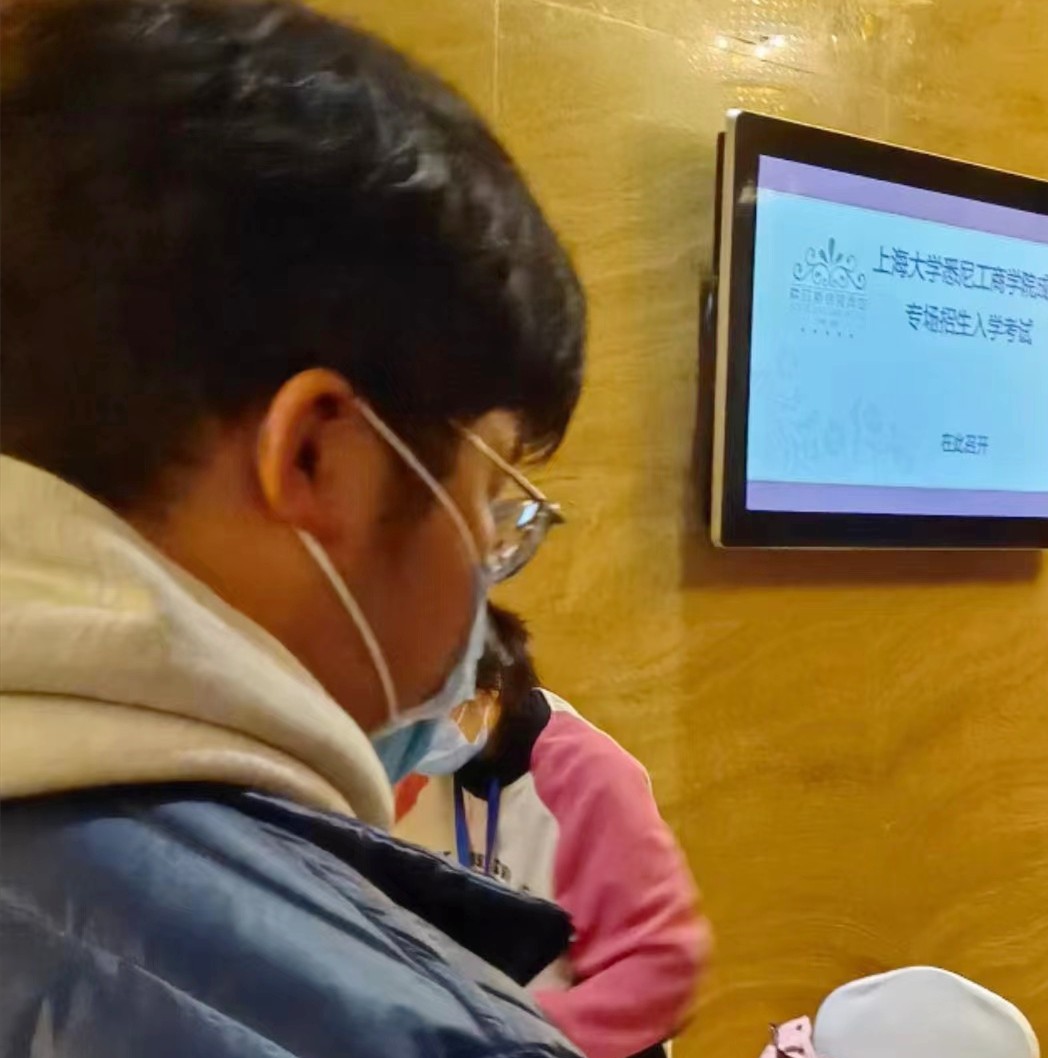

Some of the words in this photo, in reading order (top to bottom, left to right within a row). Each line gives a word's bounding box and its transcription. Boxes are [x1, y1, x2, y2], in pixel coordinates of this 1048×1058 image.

[905, 302, 1034, 345] 专场招生入学考试
